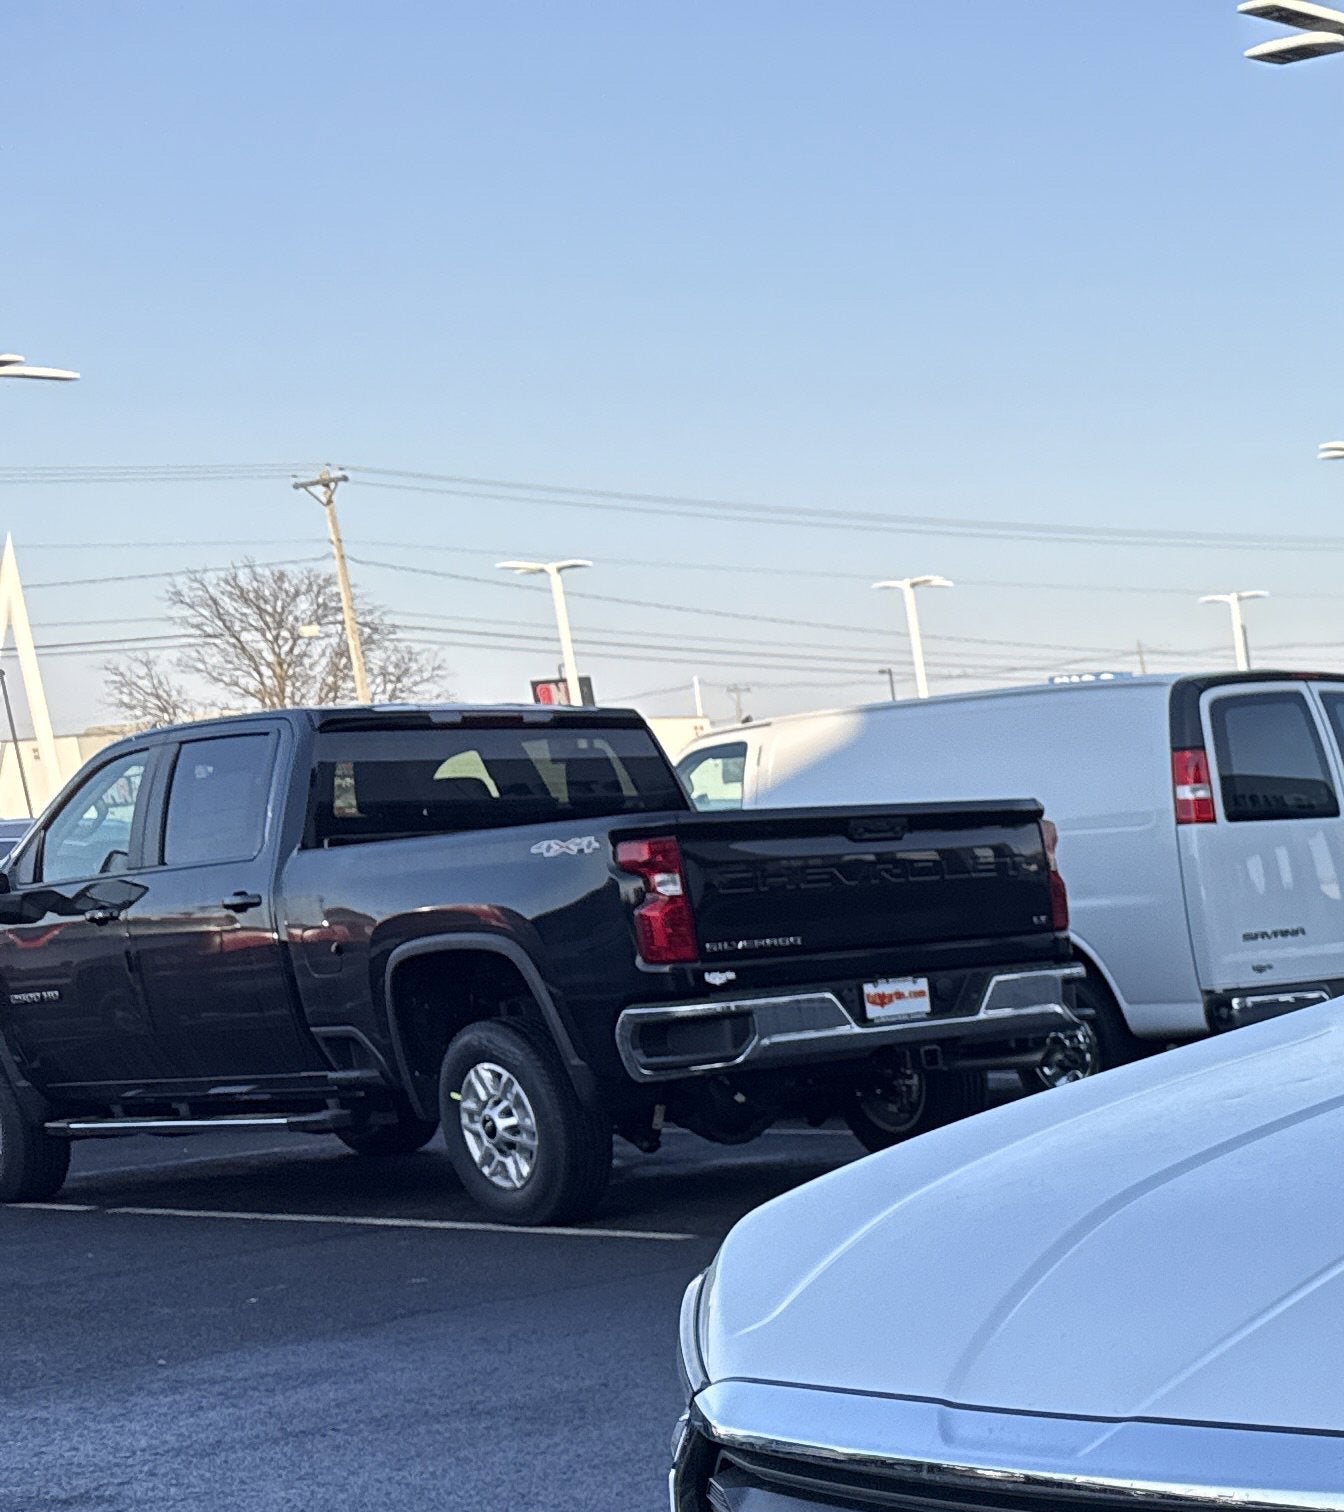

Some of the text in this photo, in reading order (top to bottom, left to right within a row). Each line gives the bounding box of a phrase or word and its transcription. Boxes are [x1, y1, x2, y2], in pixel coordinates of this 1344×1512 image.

[713, 856, 1032, 896] CHEVROLET
[1241, 926, 1307, 943] SAVANA
[705, 936, 803, 954] SILVERADO
